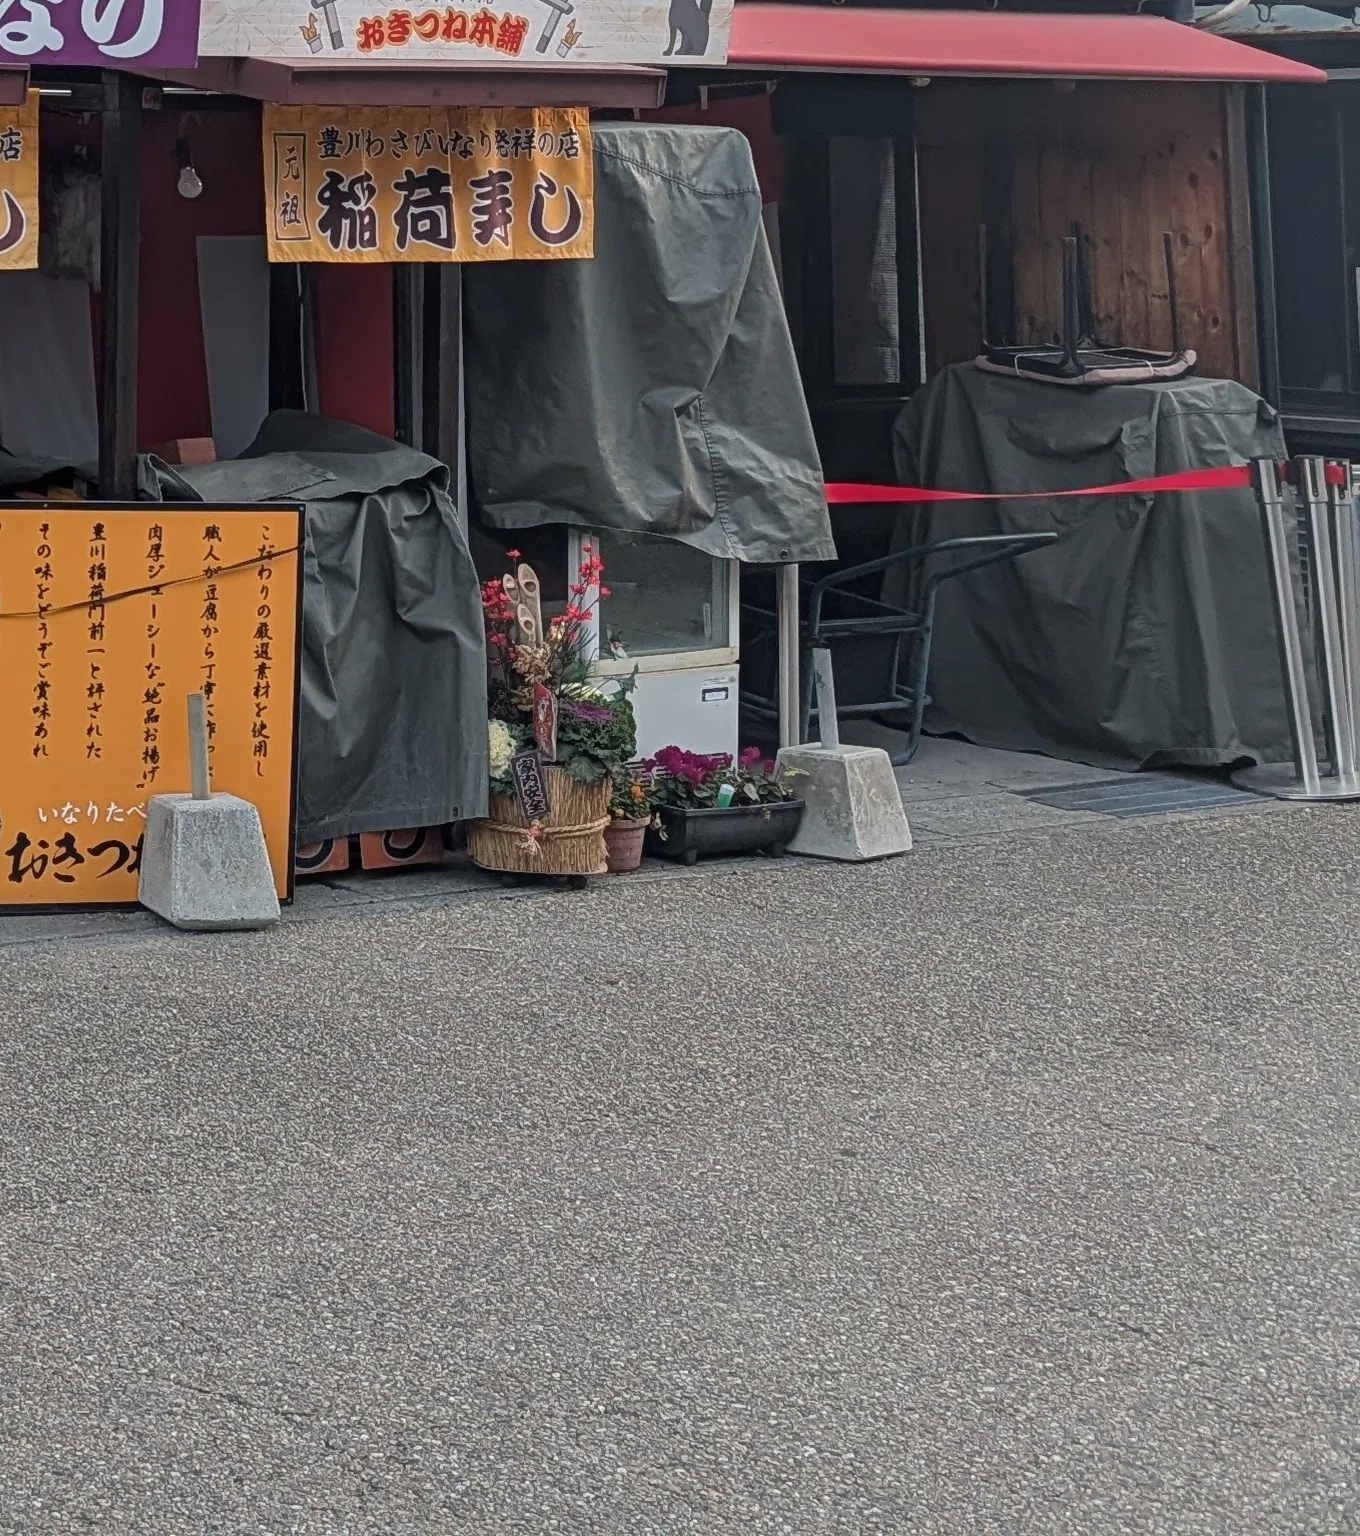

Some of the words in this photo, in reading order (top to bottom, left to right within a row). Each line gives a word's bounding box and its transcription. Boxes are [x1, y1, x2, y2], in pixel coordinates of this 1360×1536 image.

[357, 7, 529, 56] おきつね本舗
[316, 126, 581, 160] 豊川わさびいなり発祥の店
[280, 146, 302, 228] 元祖
[316, 167, 582, 251] 稲荷寿し
[32, 522, 54, 758] その味をどうぞご賞味あれ
[86, 522, 107, 760] 豊川稲荷門前一と評された
[251, 525, 276, 778] こだわりの厳選素材を使用し
